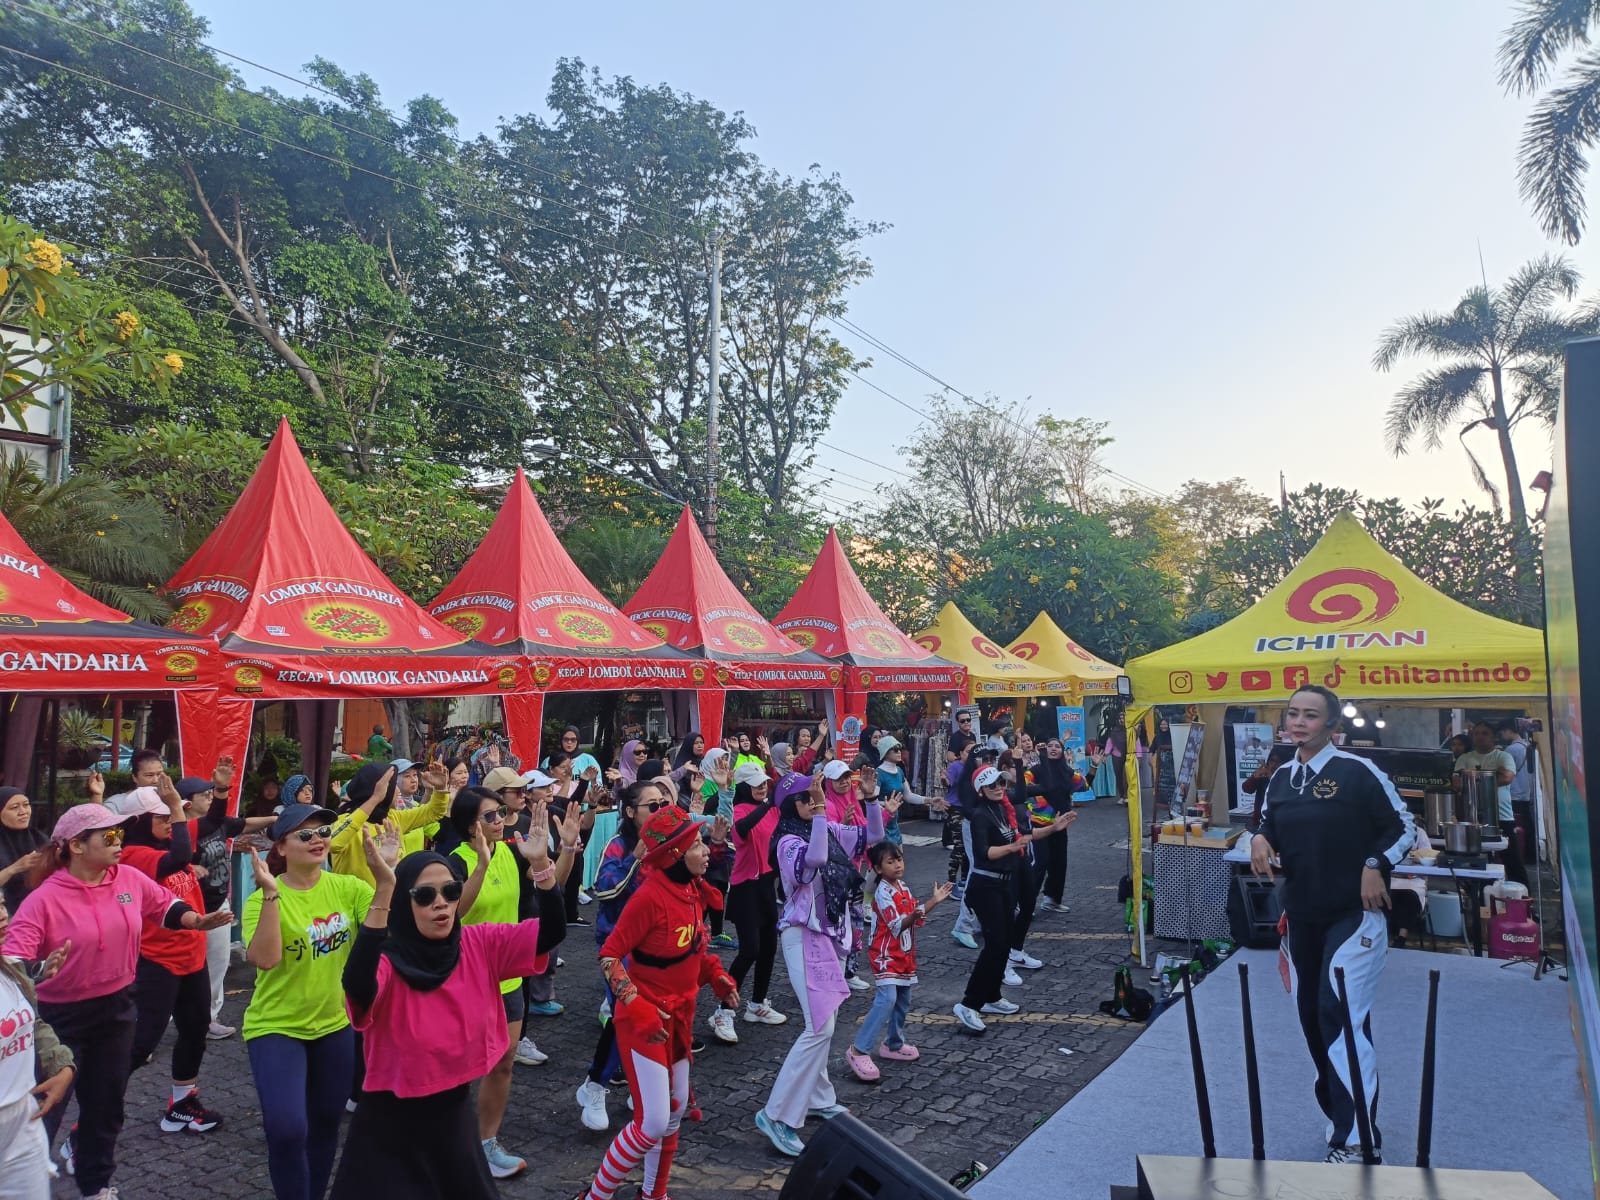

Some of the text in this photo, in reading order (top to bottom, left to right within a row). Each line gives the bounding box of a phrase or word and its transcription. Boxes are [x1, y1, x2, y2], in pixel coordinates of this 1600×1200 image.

[261, 582, 404, 608] LOMBOK GANDARIA
[431, 595, 517, 616] OMBOK GANDARIA
[526, 595, 618, 617] LOMBOK GANDARIA
[652, 610, 694, 624] GANDARIA
[801, 619, 839, 633] GANDARIA
[1255, 629, 1427, 653] ICHITAN
[155, 645, 209, 656] LOMBOK GANDARIA
[0, 652, 149, 672] GANDARIA
[277, 670, 489, 685] KECAP LOMBOK GANDARIA
[558, 668, 585, 678] KECAP
[588, 666, 632, 679] LOMBOK
[633, 666, 687, 679] GANDARIA
[753, 670, 786, 680] LOMBOK
[787, 670, 826, 680] GANDARIA
[891, 674, 919, 683] LOMBOK
[919, 674, 952, 683] GANDARIA
[1359, 662, 1531, 686] ichitanindo
[311, 928, 351, 961] TRIBE
